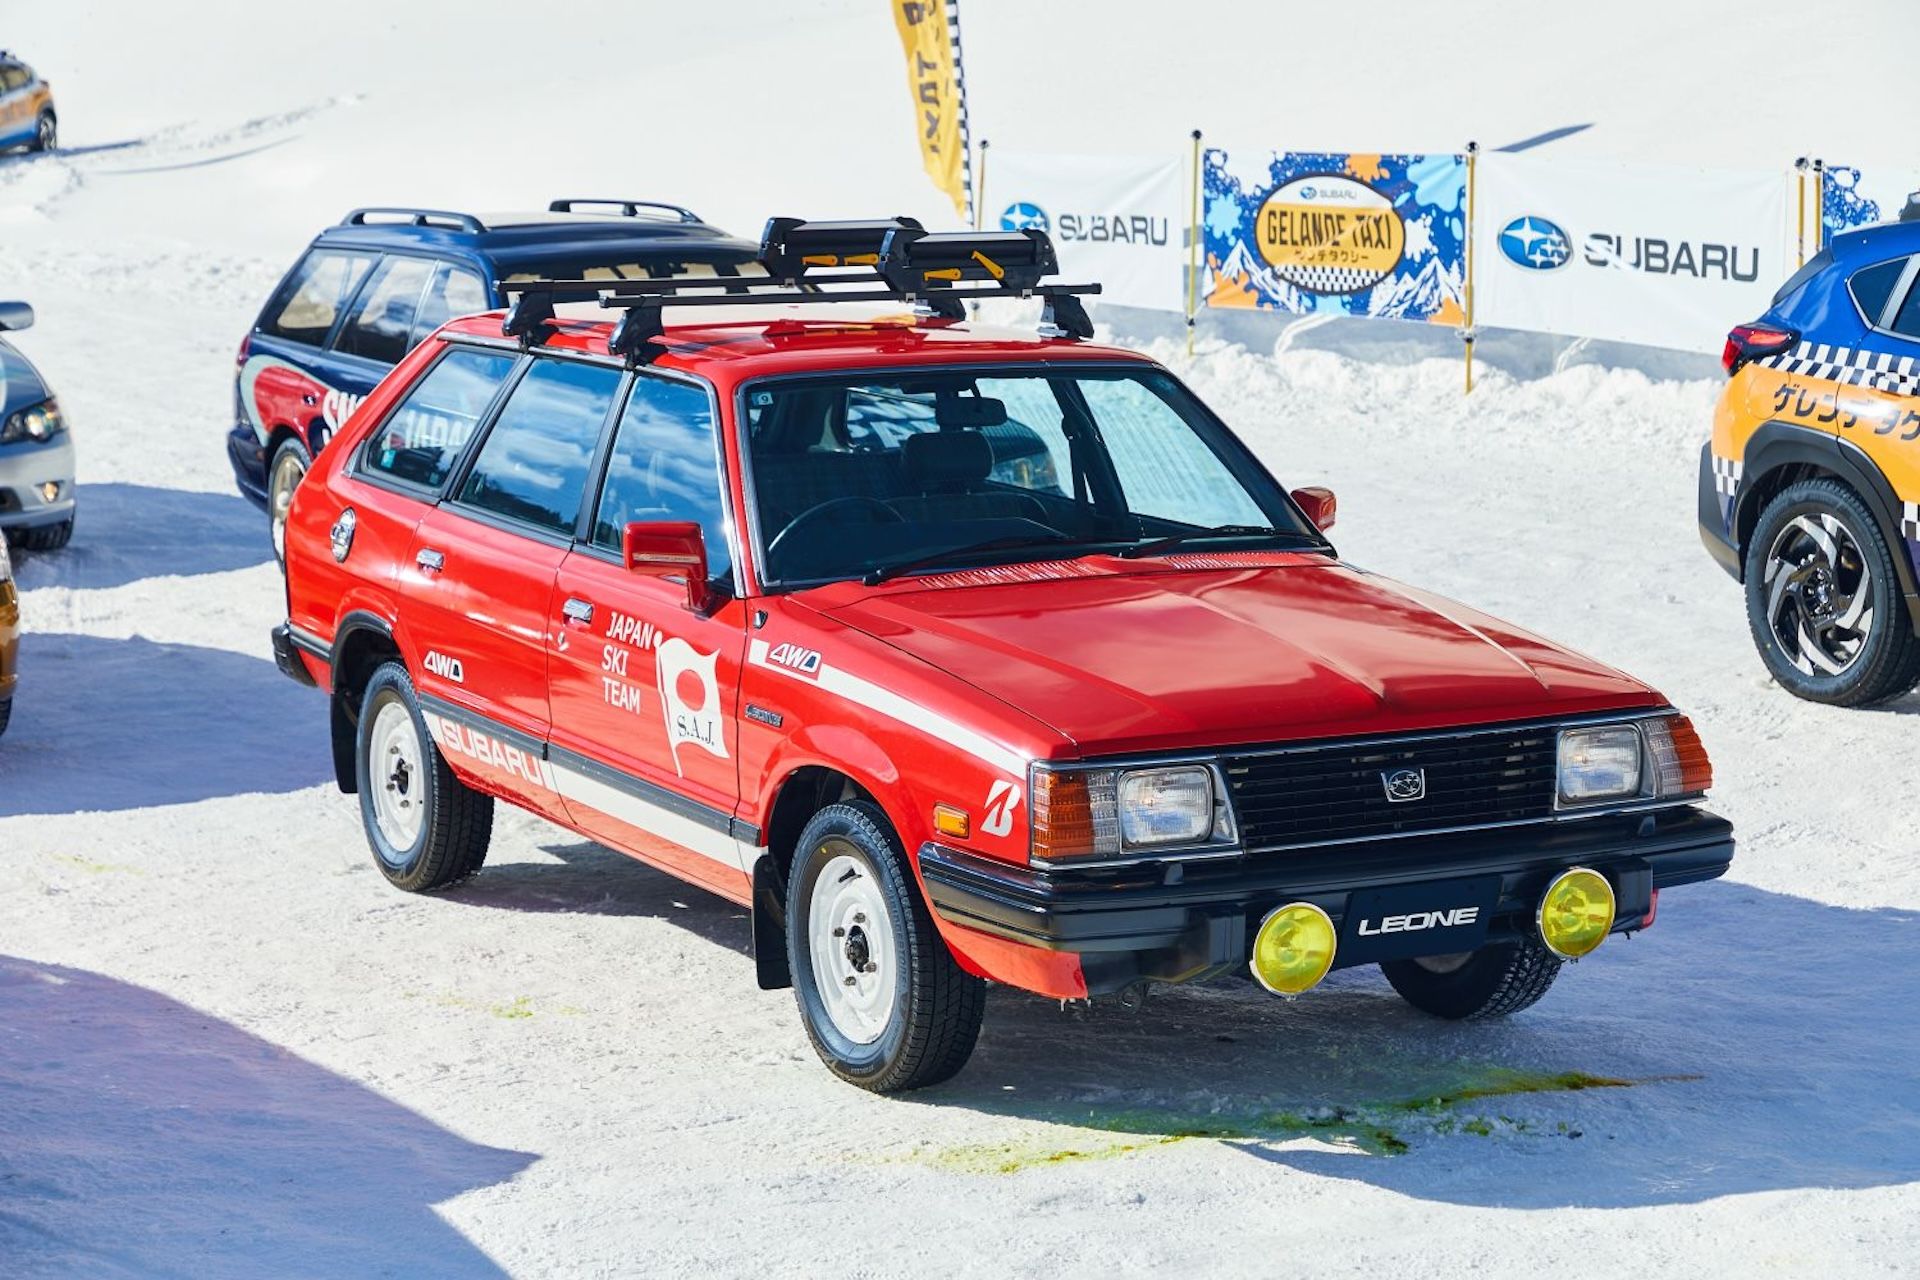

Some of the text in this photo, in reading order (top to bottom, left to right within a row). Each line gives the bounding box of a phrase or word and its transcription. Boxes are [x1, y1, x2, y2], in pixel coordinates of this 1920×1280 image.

[1319, 189, 1358, 200] SUBARU
[1058, 214, 1169, 247] SUBARU
[1267, 210, 1346, 248] GELANDE
[1584, 233, 1760, 283] SUBARU
[605, 611, 655, 650] JAPAN
[423, 650, 464, 684] 4WD
[601, 644, 630, 677] SKI
[767, 643, 823, 674] 4WD
[601, 676, 642, 715] TEAM
[440, 718, 545, 787] SUBARU
[1357, 906, 1481, 937] LEONE
